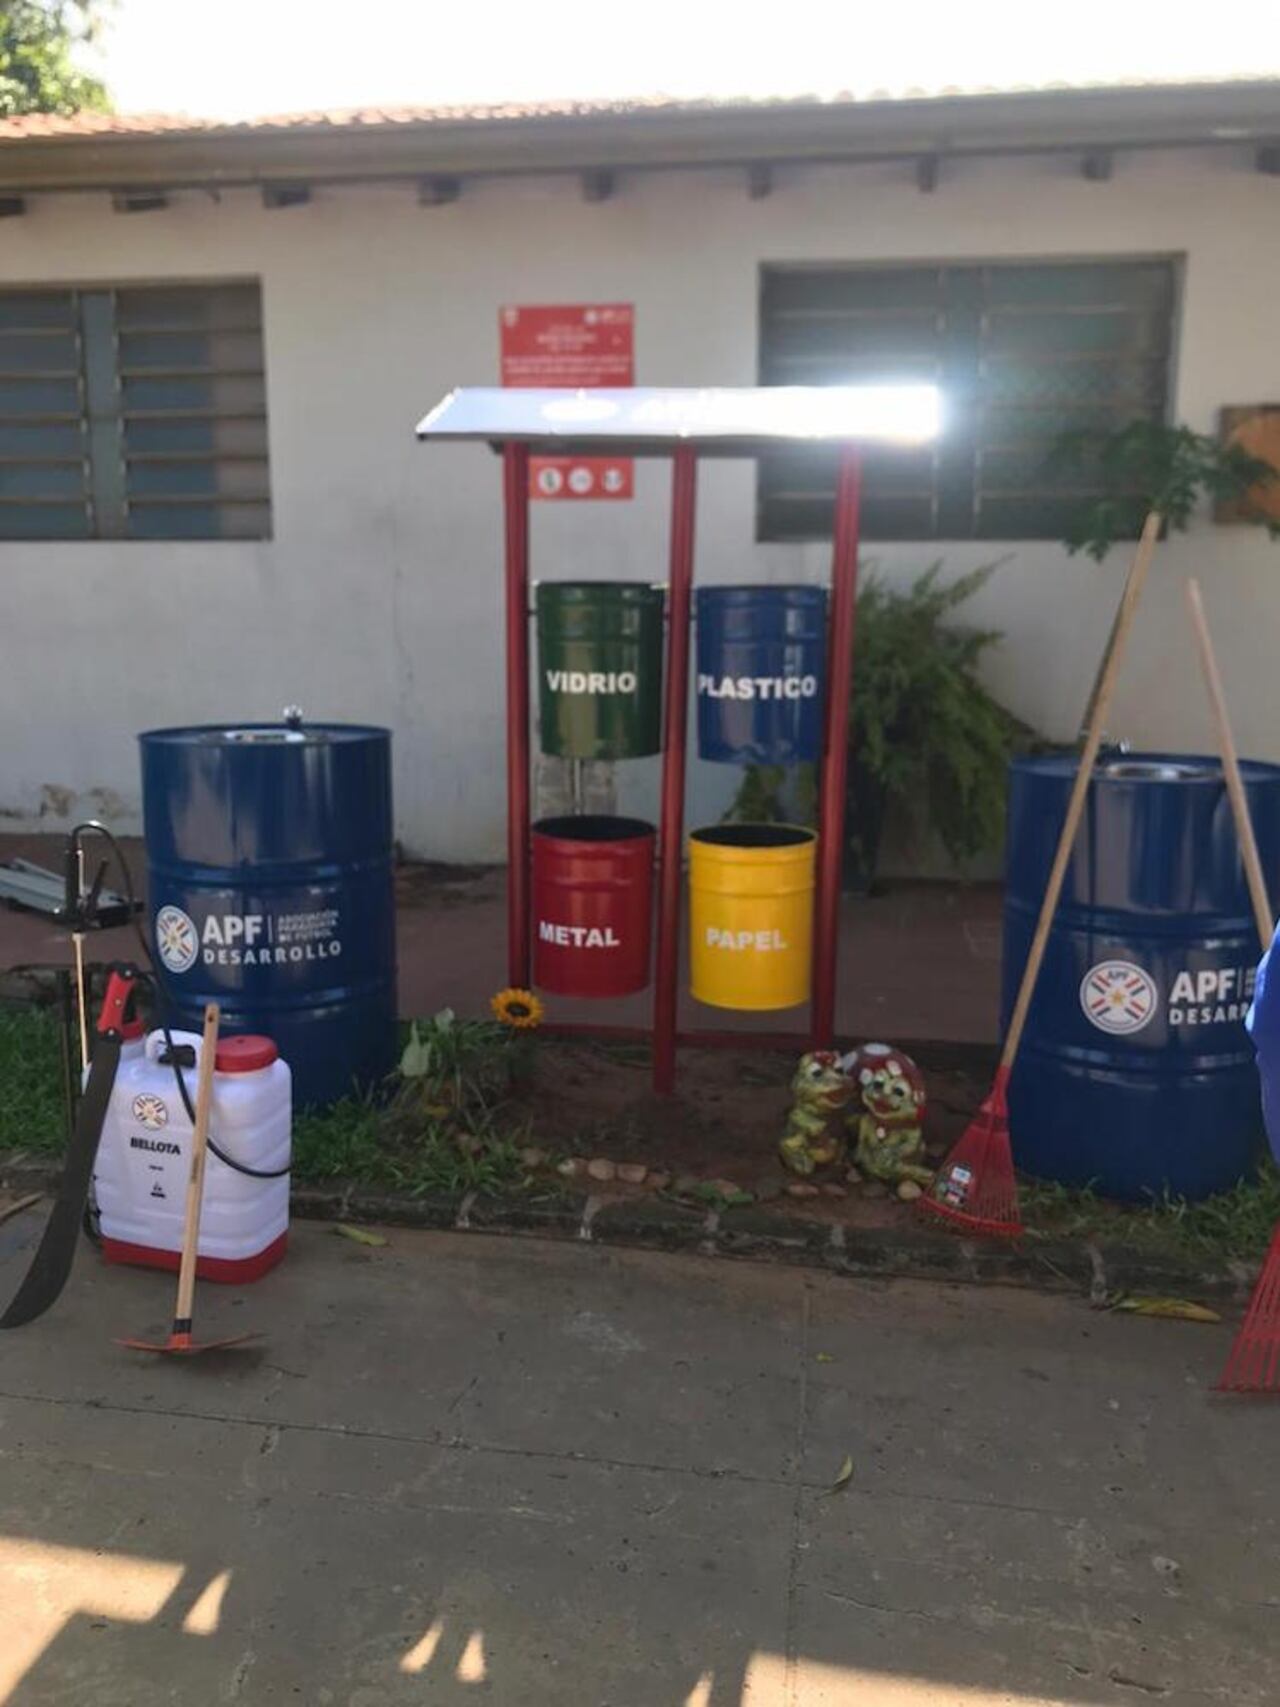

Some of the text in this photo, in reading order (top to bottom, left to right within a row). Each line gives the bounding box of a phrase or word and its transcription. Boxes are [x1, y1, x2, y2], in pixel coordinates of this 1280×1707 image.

[546, 670, 637, 694] VIDRIO
[698, 674, 816, 699] PLASTICO
[202, 915, 263, 945] APF
[539, 921, 620, 948] METAL
[706, 927, 787, 951] PAPEL
[203, 941, 341, 964] DESARROLLO
[1169, 969, 1236, 1004] APF
[130, 1137, 181, 1155] BELLOTA
